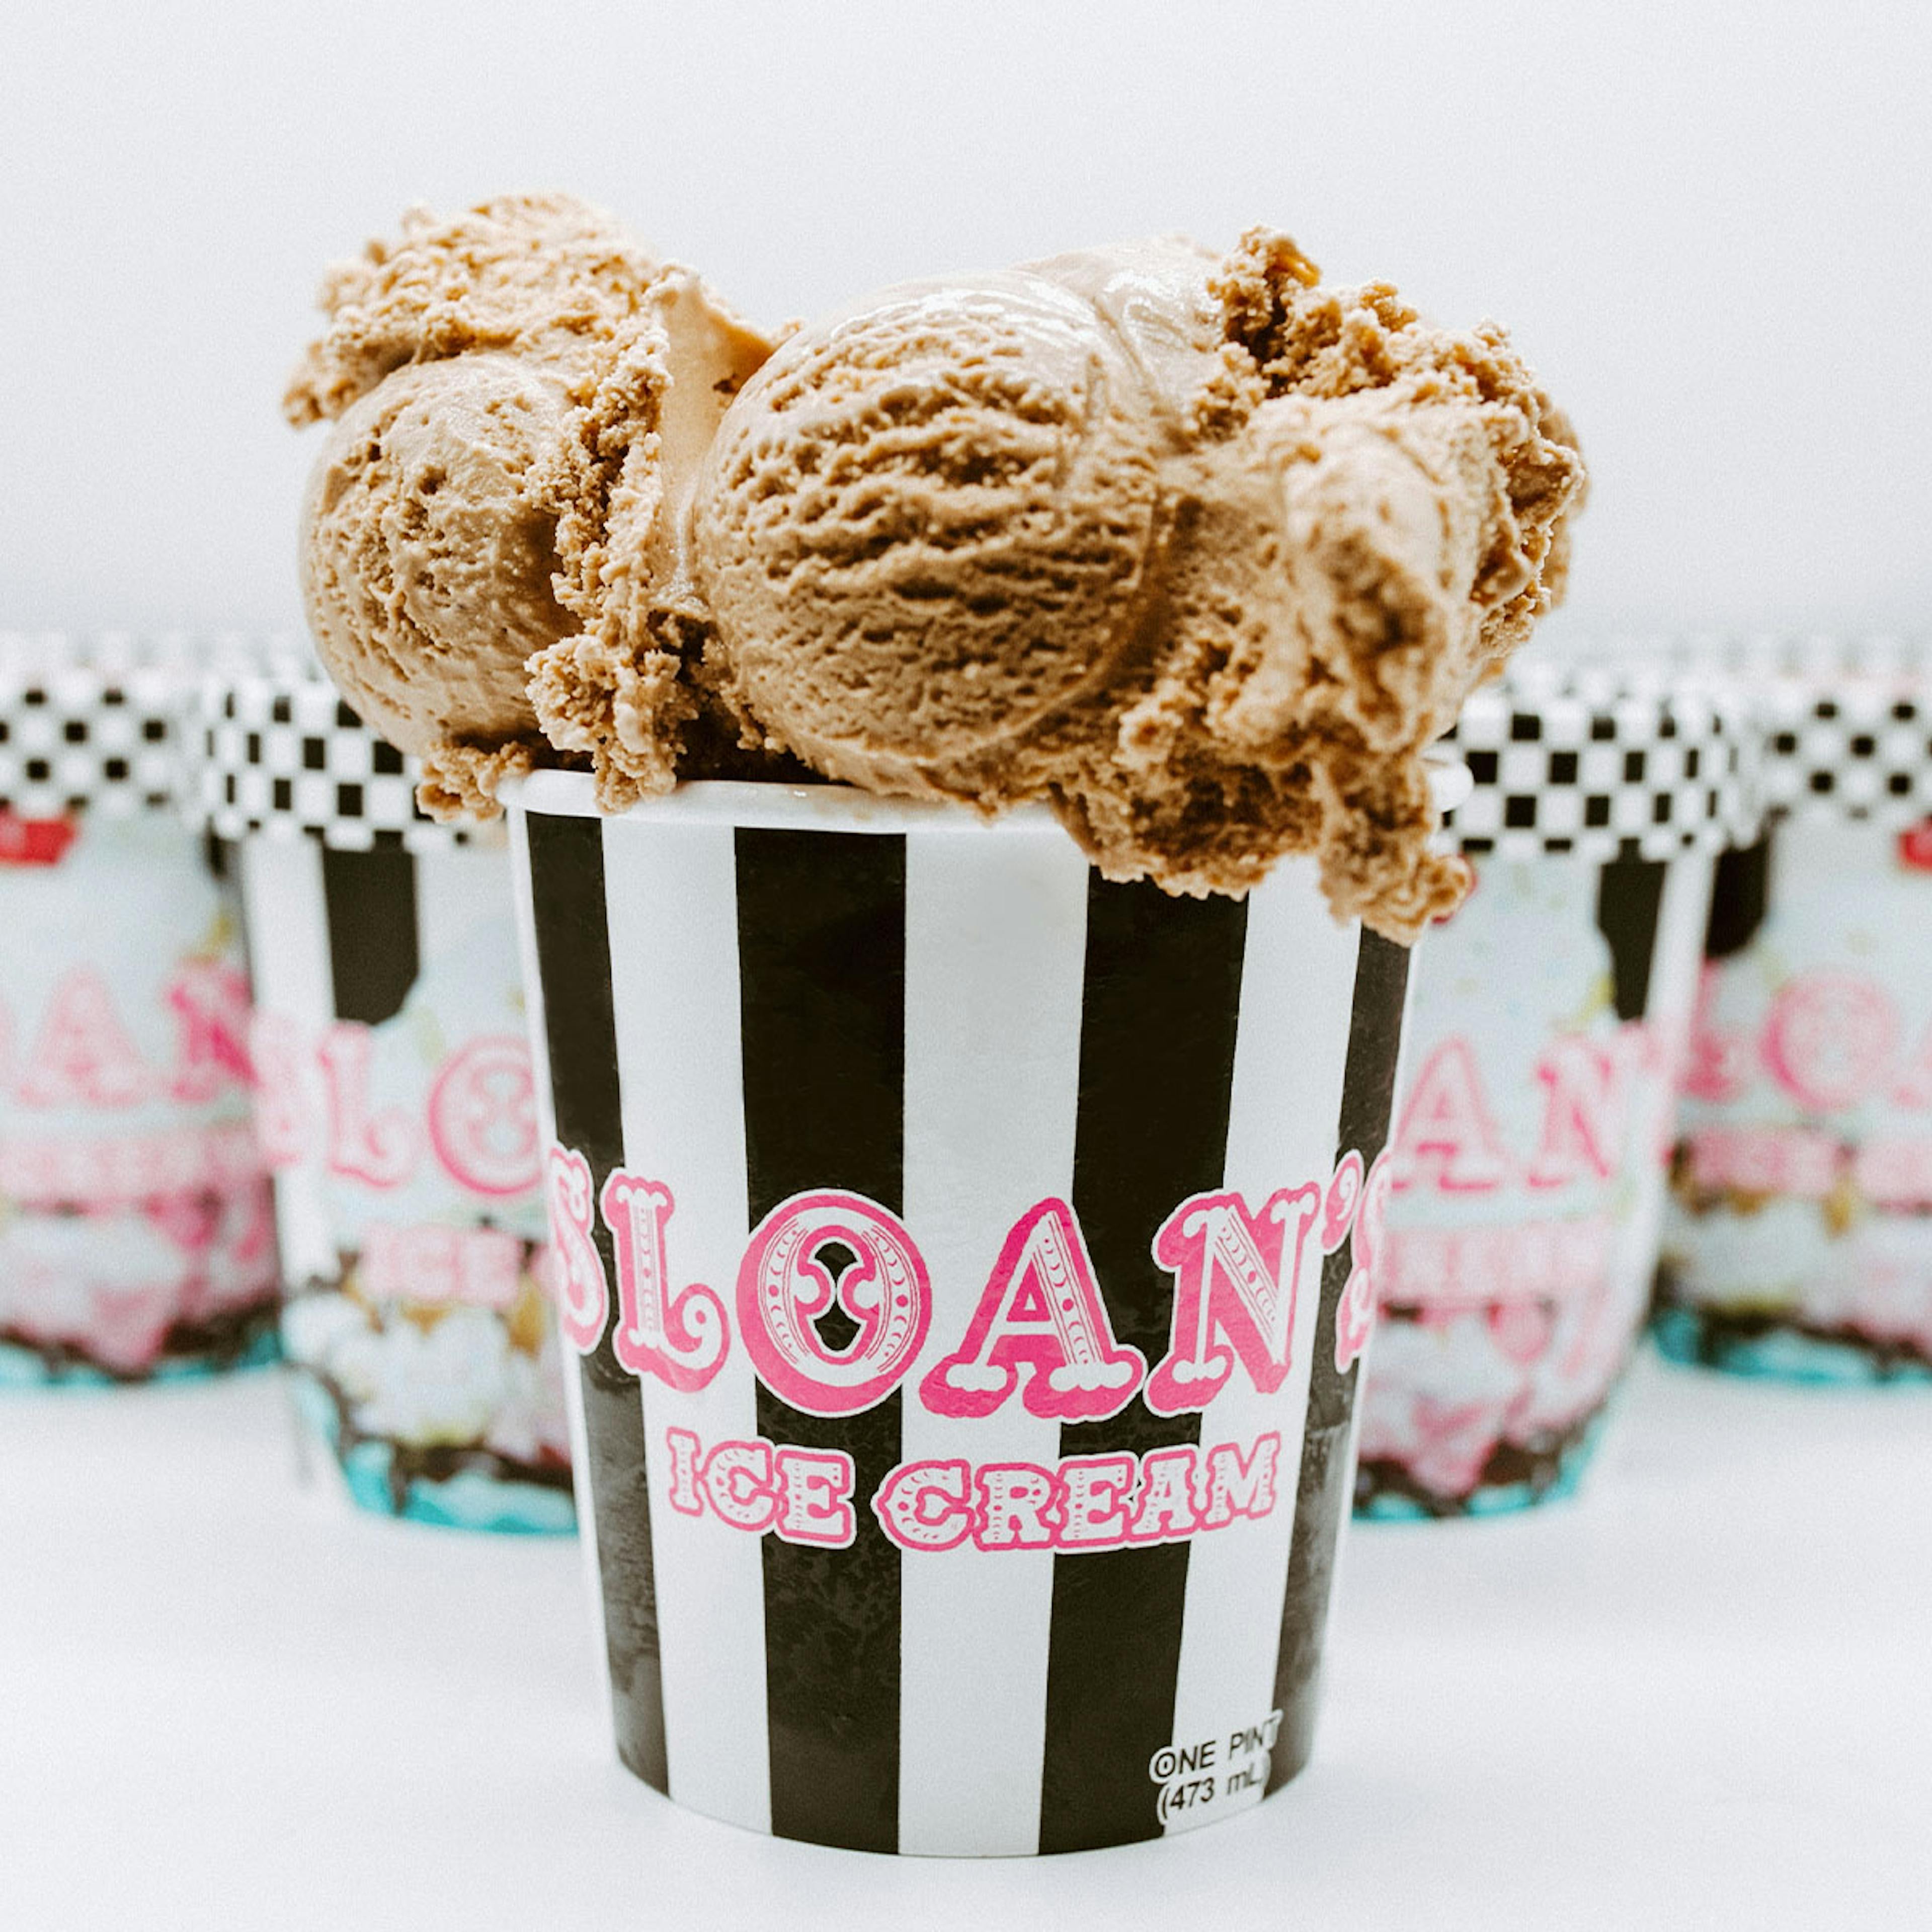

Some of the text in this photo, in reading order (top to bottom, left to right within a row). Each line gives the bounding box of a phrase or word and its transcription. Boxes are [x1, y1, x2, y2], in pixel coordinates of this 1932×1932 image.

[665, 1427, 1281, 1552] ICE CREAM
[1155, 1715, 1278, 1778] ONE PINT
[1161, 1778, 1215, 1820] (473
